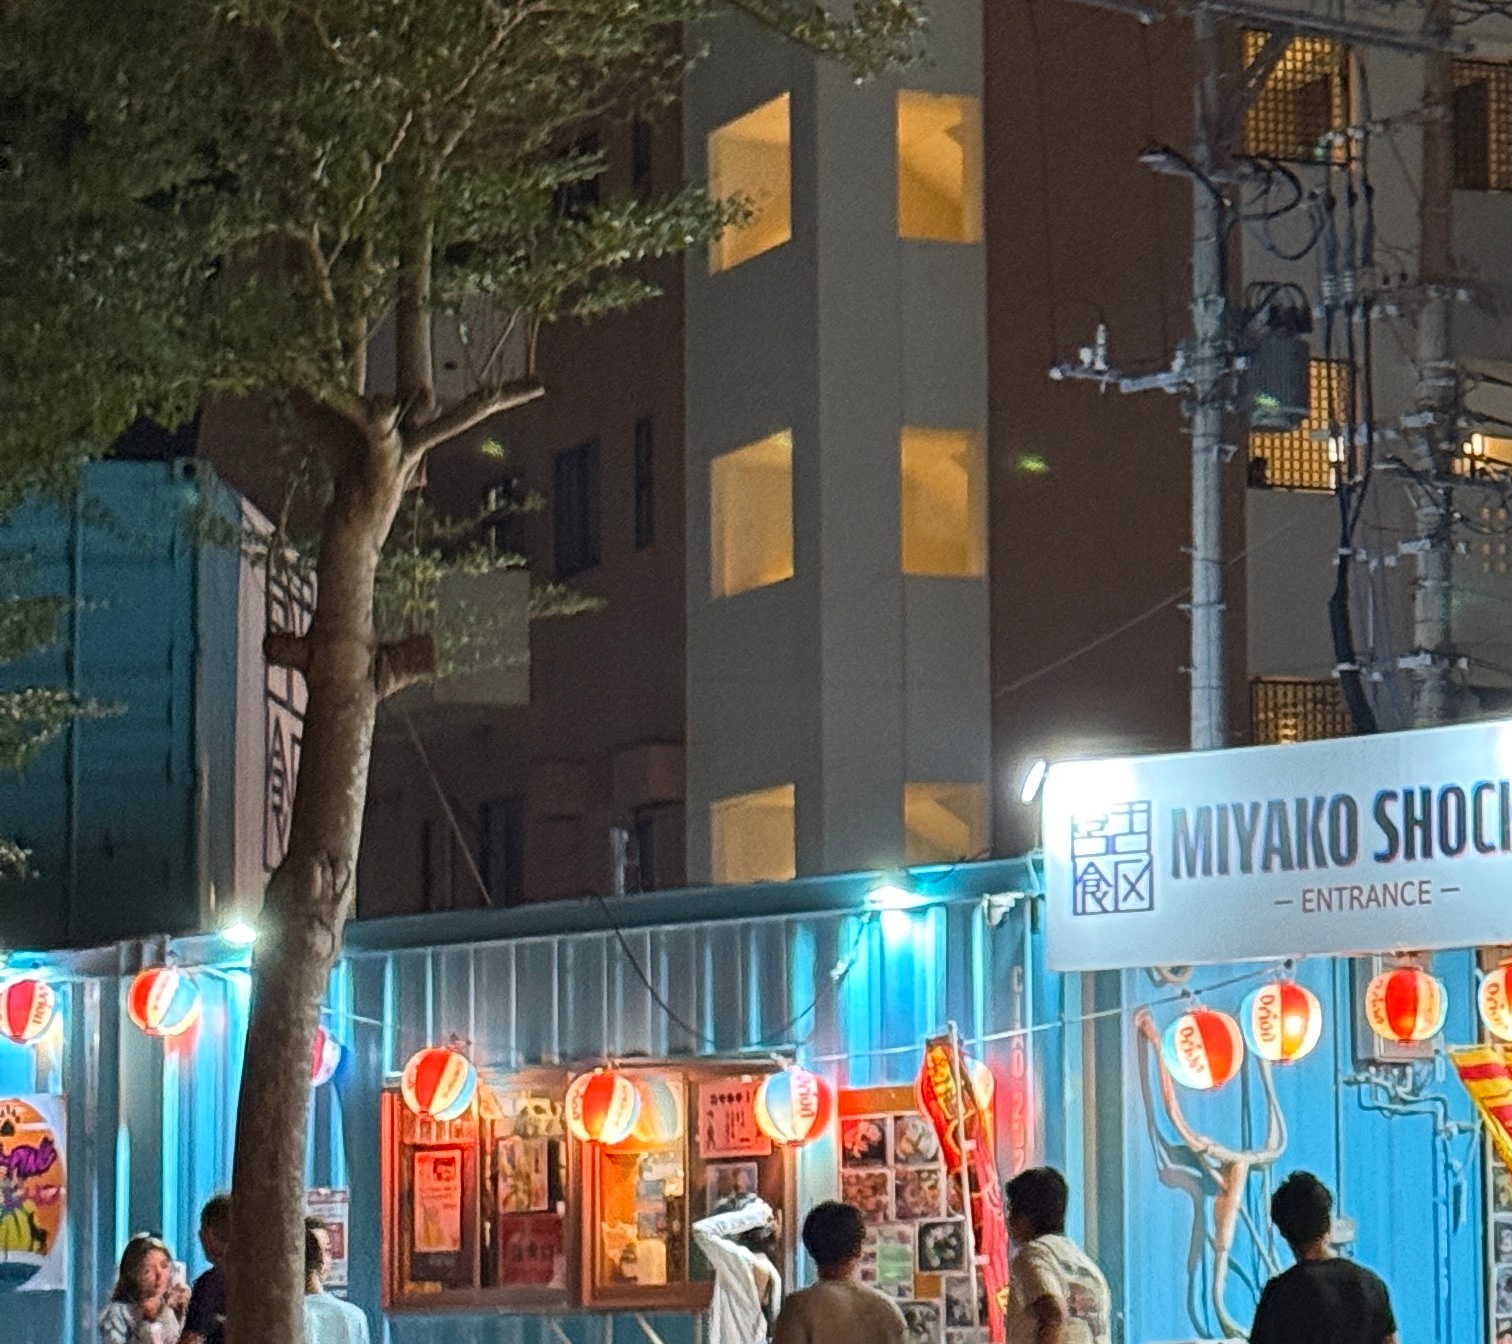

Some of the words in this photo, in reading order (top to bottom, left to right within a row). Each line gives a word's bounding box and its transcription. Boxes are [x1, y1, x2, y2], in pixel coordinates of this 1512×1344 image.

[1171, 793, 1359, 879] MIYAKO
[1302, 879, 1432, 913] ENTRANCE
[1259, 994, 1277, 1043] Orion
